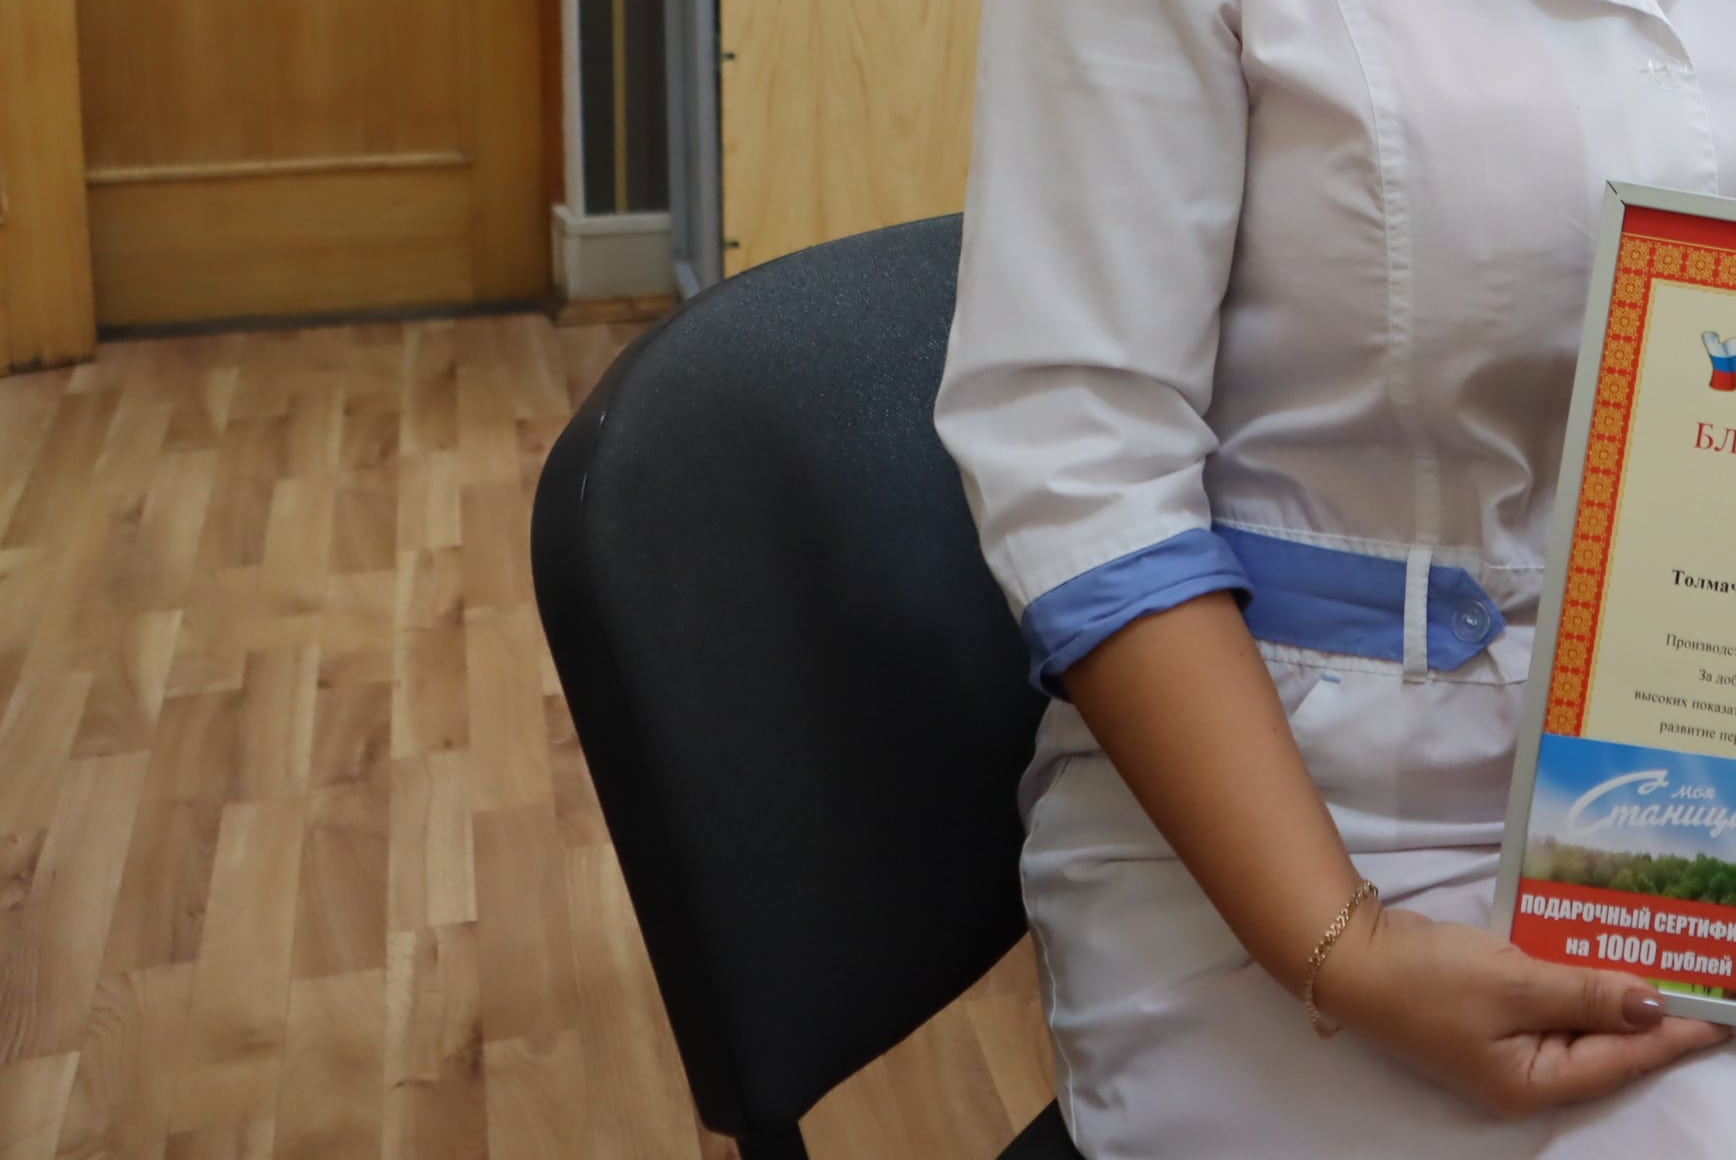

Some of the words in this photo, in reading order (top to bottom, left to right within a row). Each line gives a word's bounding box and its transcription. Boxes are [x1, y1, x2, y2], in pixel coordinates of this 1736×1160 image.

[1698, 668, 1713, 682] За
[1634, 690, 1688, 709] высоких
[1659, 720, 1717, 740] развитие
[1520, 893, 1651, 931] ПОДАРОЧНЫЙ
[1565, 937, 1590, 957] на
[1596, 933, 1657, 966] 1000
[1660, 950, 1734, 977] рублей
